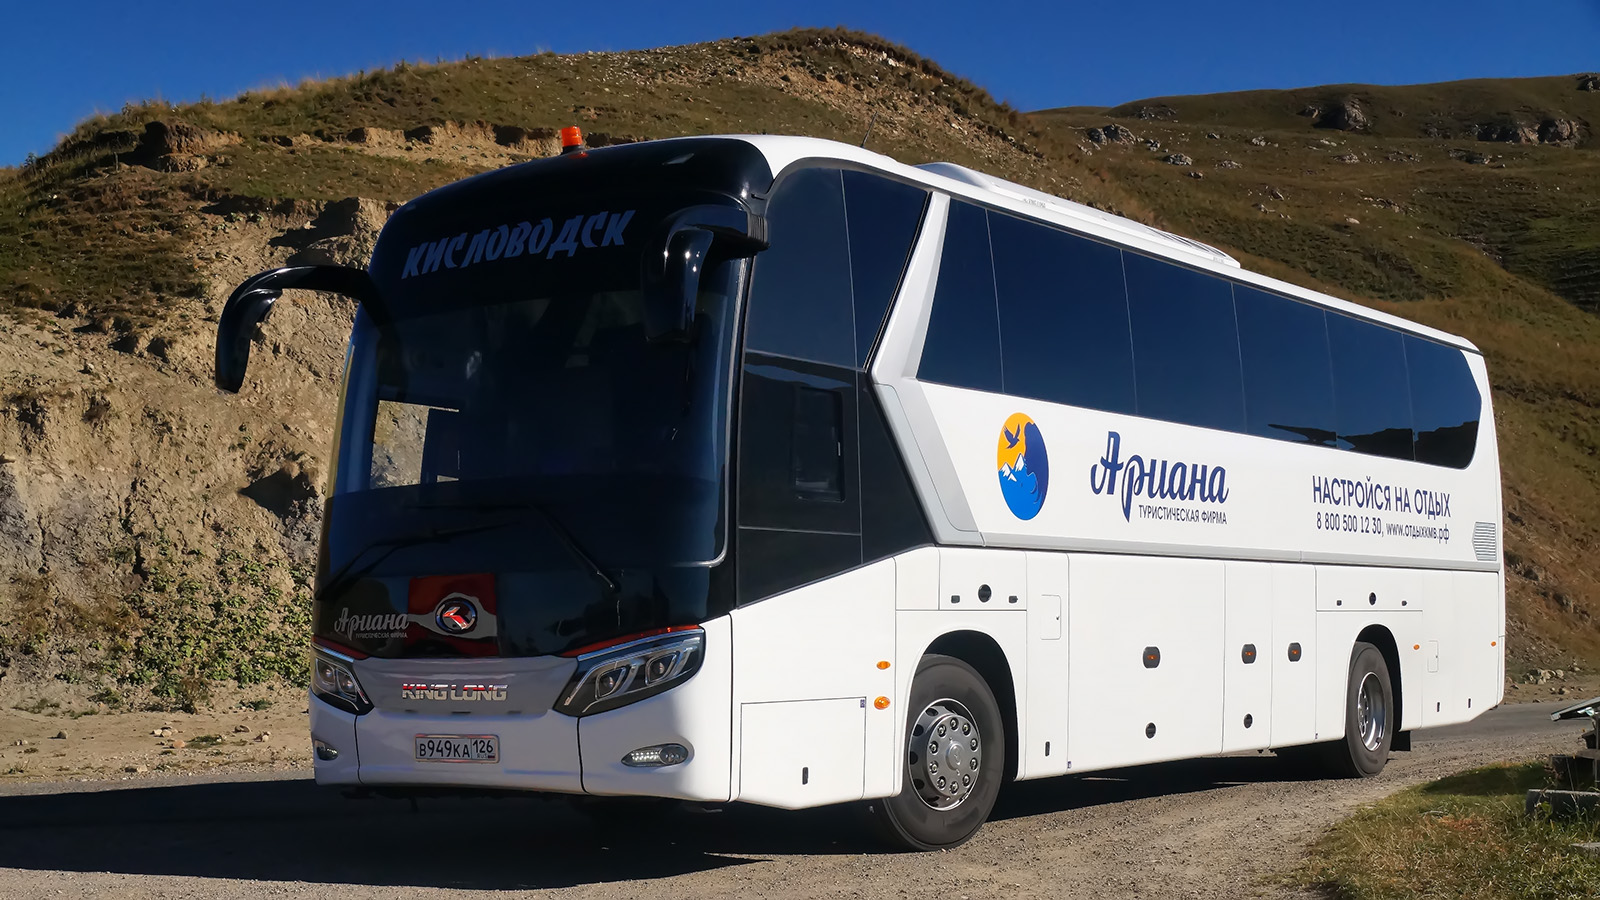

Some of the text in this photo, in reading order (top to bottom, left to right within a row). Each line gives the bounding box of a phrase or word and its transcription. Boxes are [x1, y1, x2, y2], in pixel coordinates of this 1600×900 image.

[401, 210, 636, 279] КИСЛОВОДСК
[1090, 431, 1229, 523] Ариана
[1312, 475, 1451, 520] НАСТРОЙСЯ НА ОТДЫХ
[1139, 504, 1227, 524] ТУРИСТИЧЕСКАЯ ФИРМА
[1316, 512, 1322, 530] 8
[1324, 512, 1340, 531] 800
[1342, 514, 1358, 532] 500
[1360, 516, 1370, 534] 12
[1372, 517, 1384, 538] 30,
[334, 607, 410, 641] Ариана
[402, 683, 508, 701] KING LONG
[419, 739, 494, 758] В949КА 126
